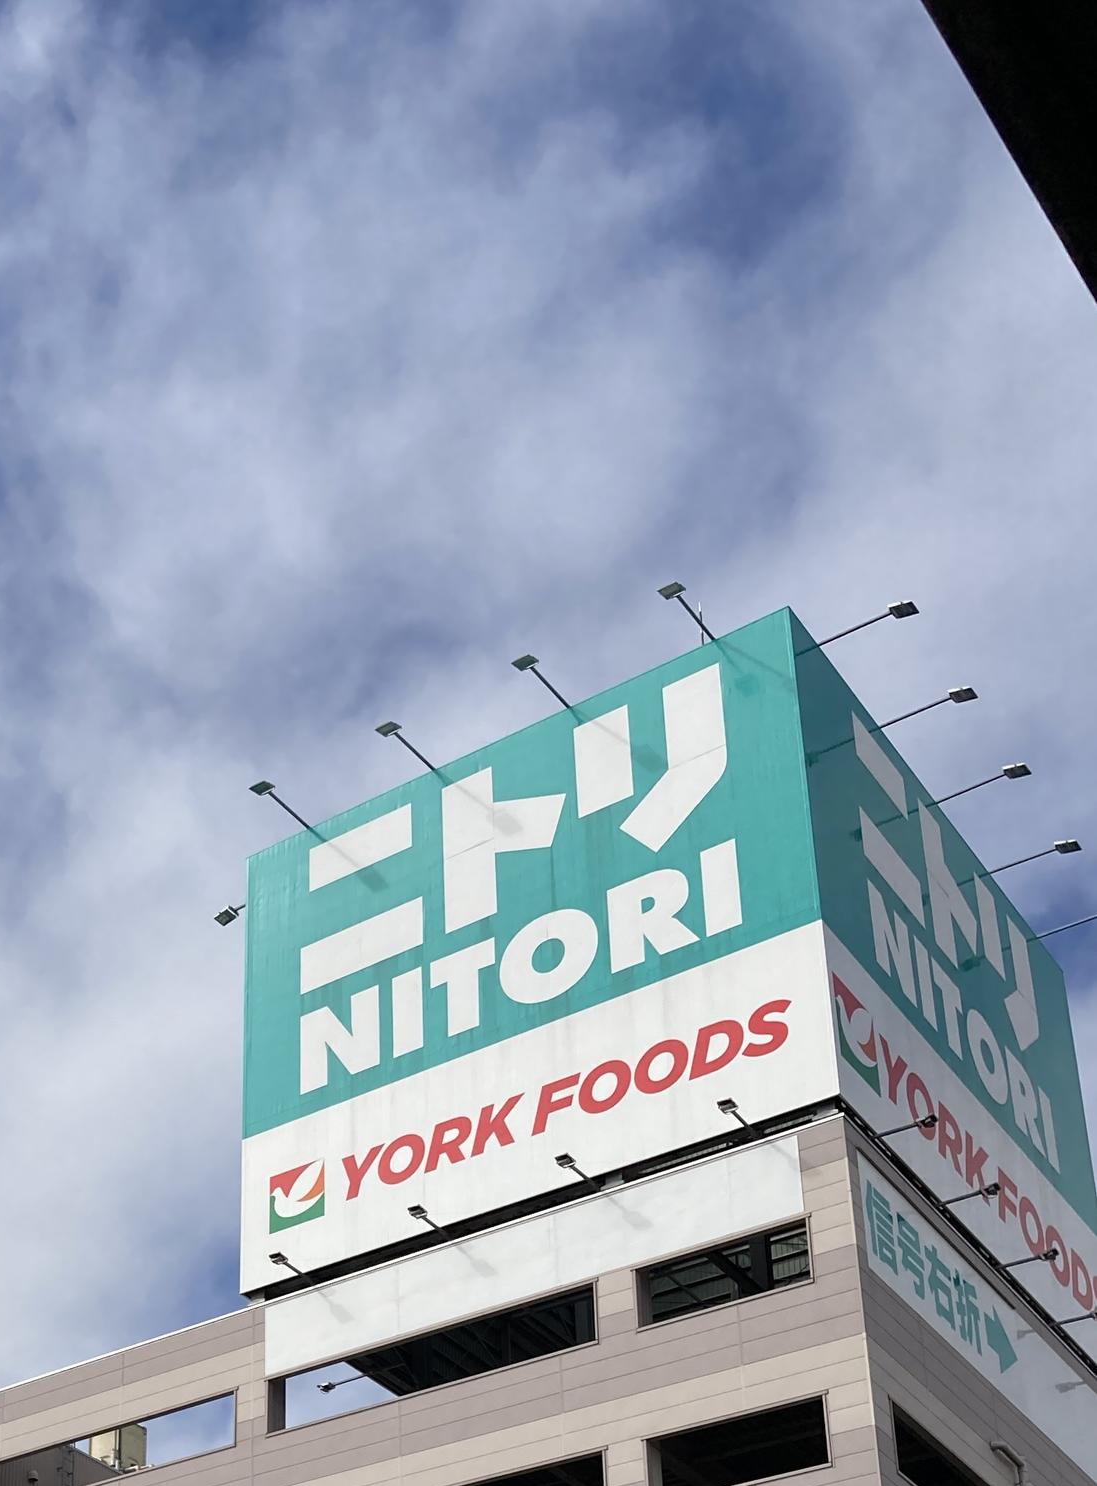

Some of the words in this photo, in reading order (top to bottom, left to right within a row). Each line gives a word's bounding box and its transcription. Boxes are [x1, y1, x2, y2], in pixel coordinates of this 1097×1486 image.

[299, 662, 728, 994] ニトリ
[299, 838, 744, 1096] NITORI
[853, 710, 1040, 1051] ニトリ
[341, 1093, 525, 1203] YORK
[532, 999, 793, 1135] FOODS
[868, 880, 1061, 1175] NITORI
[865, 1179, 983, 1357] 信号右折
[878, 1032, 990, 1204] YORK
[997, 1166, 1097, 1314] FOOD
